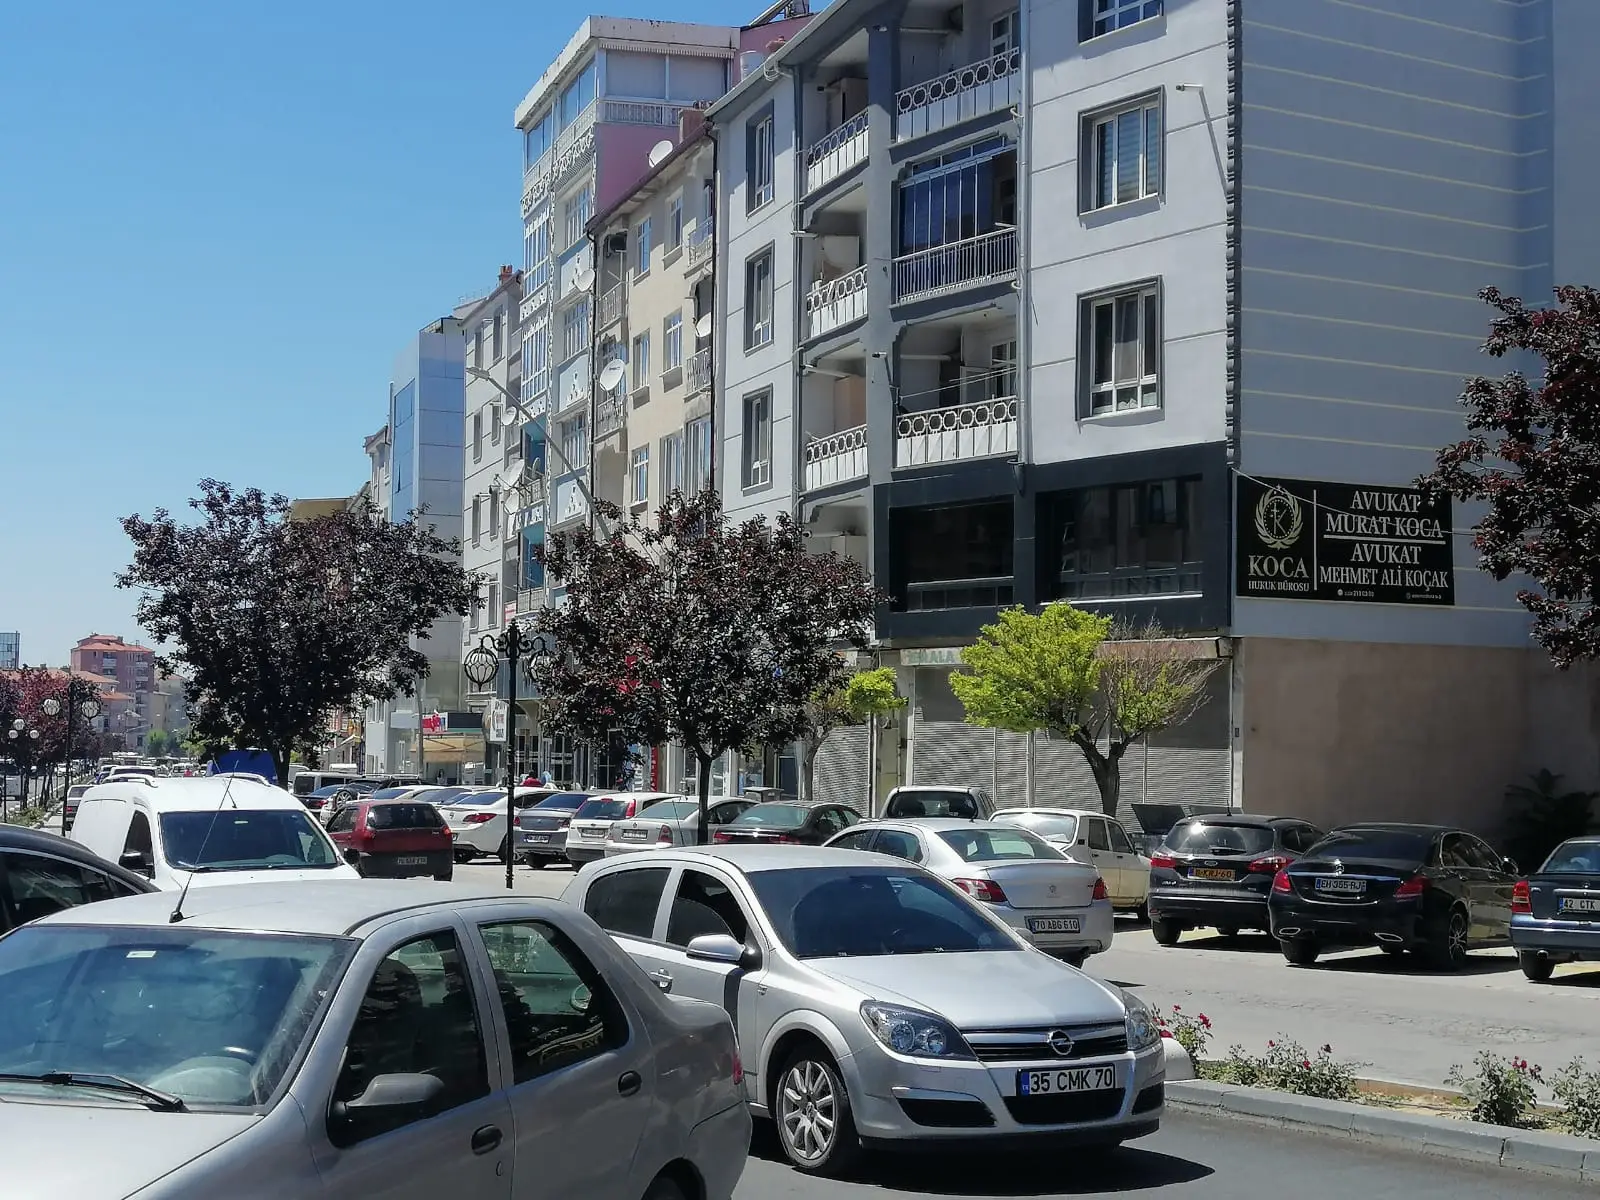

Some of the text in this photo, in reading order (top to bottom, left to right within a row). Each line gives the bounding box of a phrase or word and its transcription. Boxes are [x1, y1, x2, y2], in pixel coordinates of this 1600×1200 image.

[1350, 490, 1421, 513] AVUKAT
[1326, 512, 1444, 538] MURAT KOCA
[1350, 542, 1422, 565] AVUKAT
[1248, 555, 1310, 578] KOCA
[1248, 579, 1310, 592] HUKUK BÜROSU
[1320, 565, 1449, 592] MEHMET ALİ KOÇAK
[1564, 898, 1574, 909] 42
[1034, 920, 1046, 930] 70
[1030, 1067, 1113, 1093] 35 CMK 70
